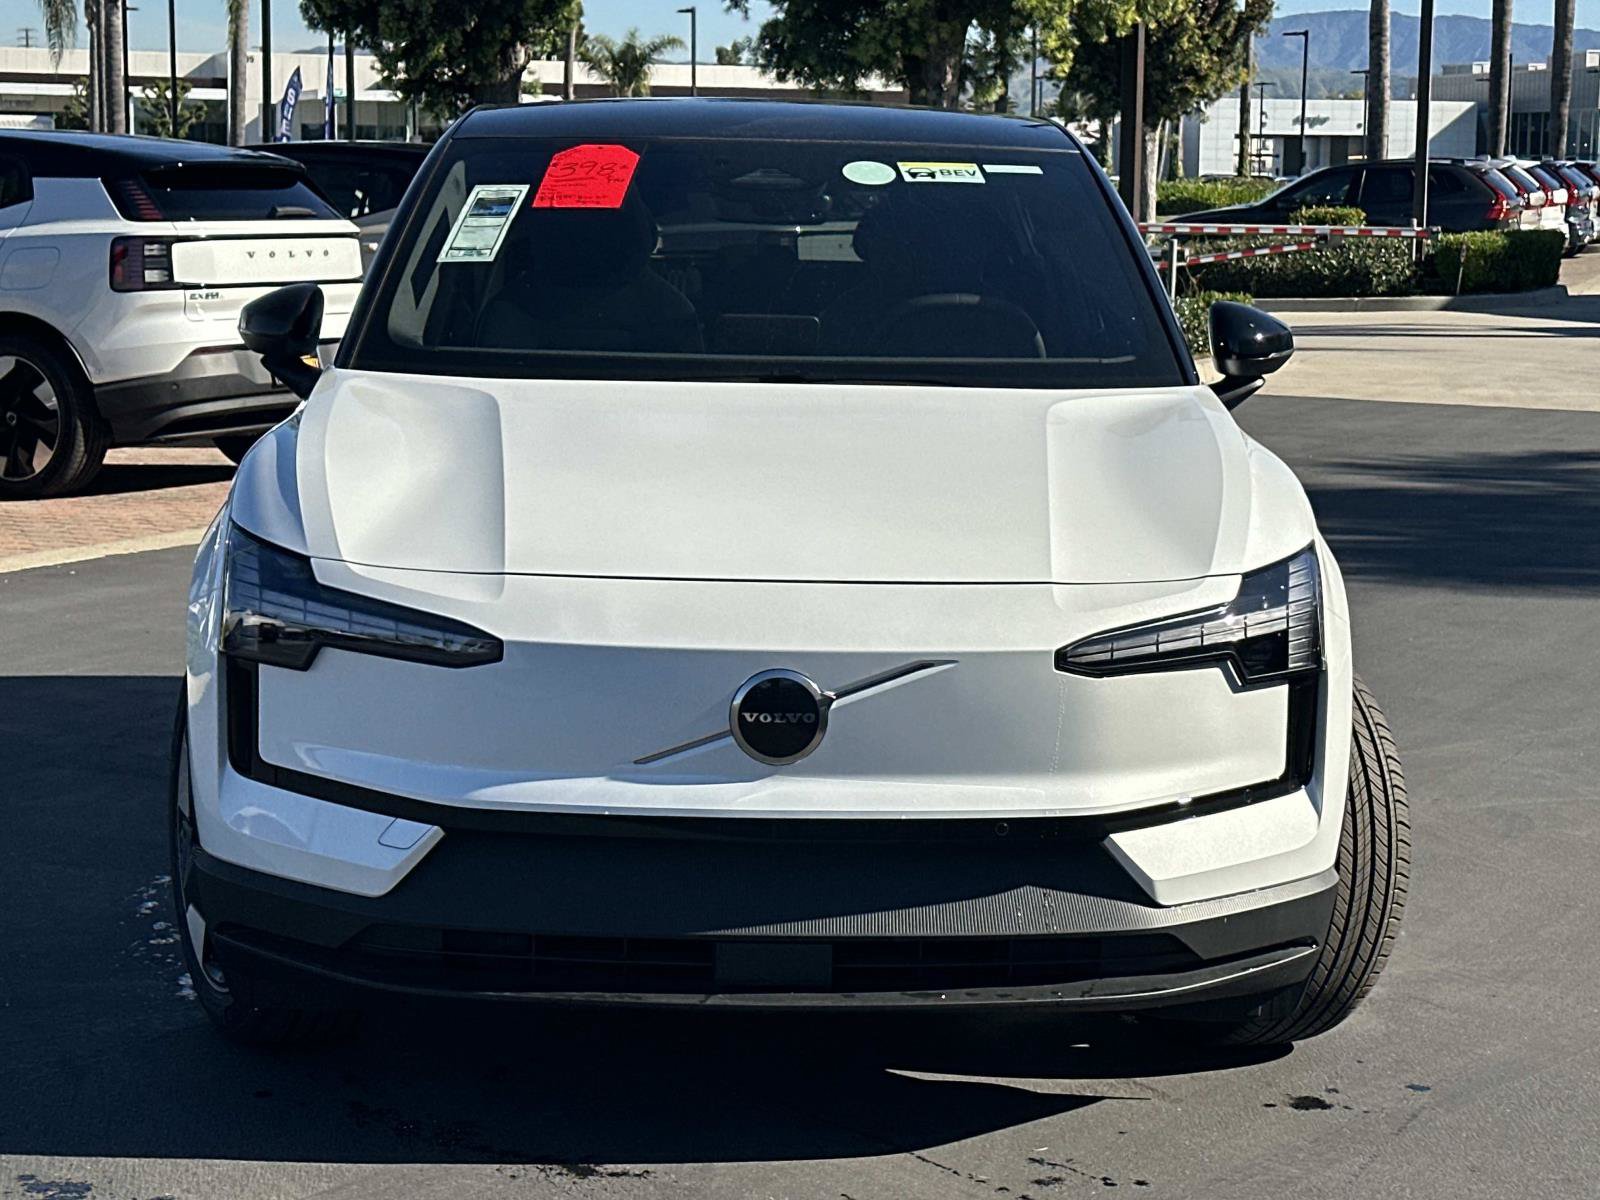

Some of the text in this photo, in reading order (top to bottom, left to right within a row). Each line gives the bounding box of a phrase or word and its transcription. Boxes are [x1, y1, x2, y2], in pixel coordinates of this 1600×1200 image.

[939, 168, 977, 177] BEV
[246, 248, 330, 259] VOLVO
[741, 712, 817, 724] VOLVO
